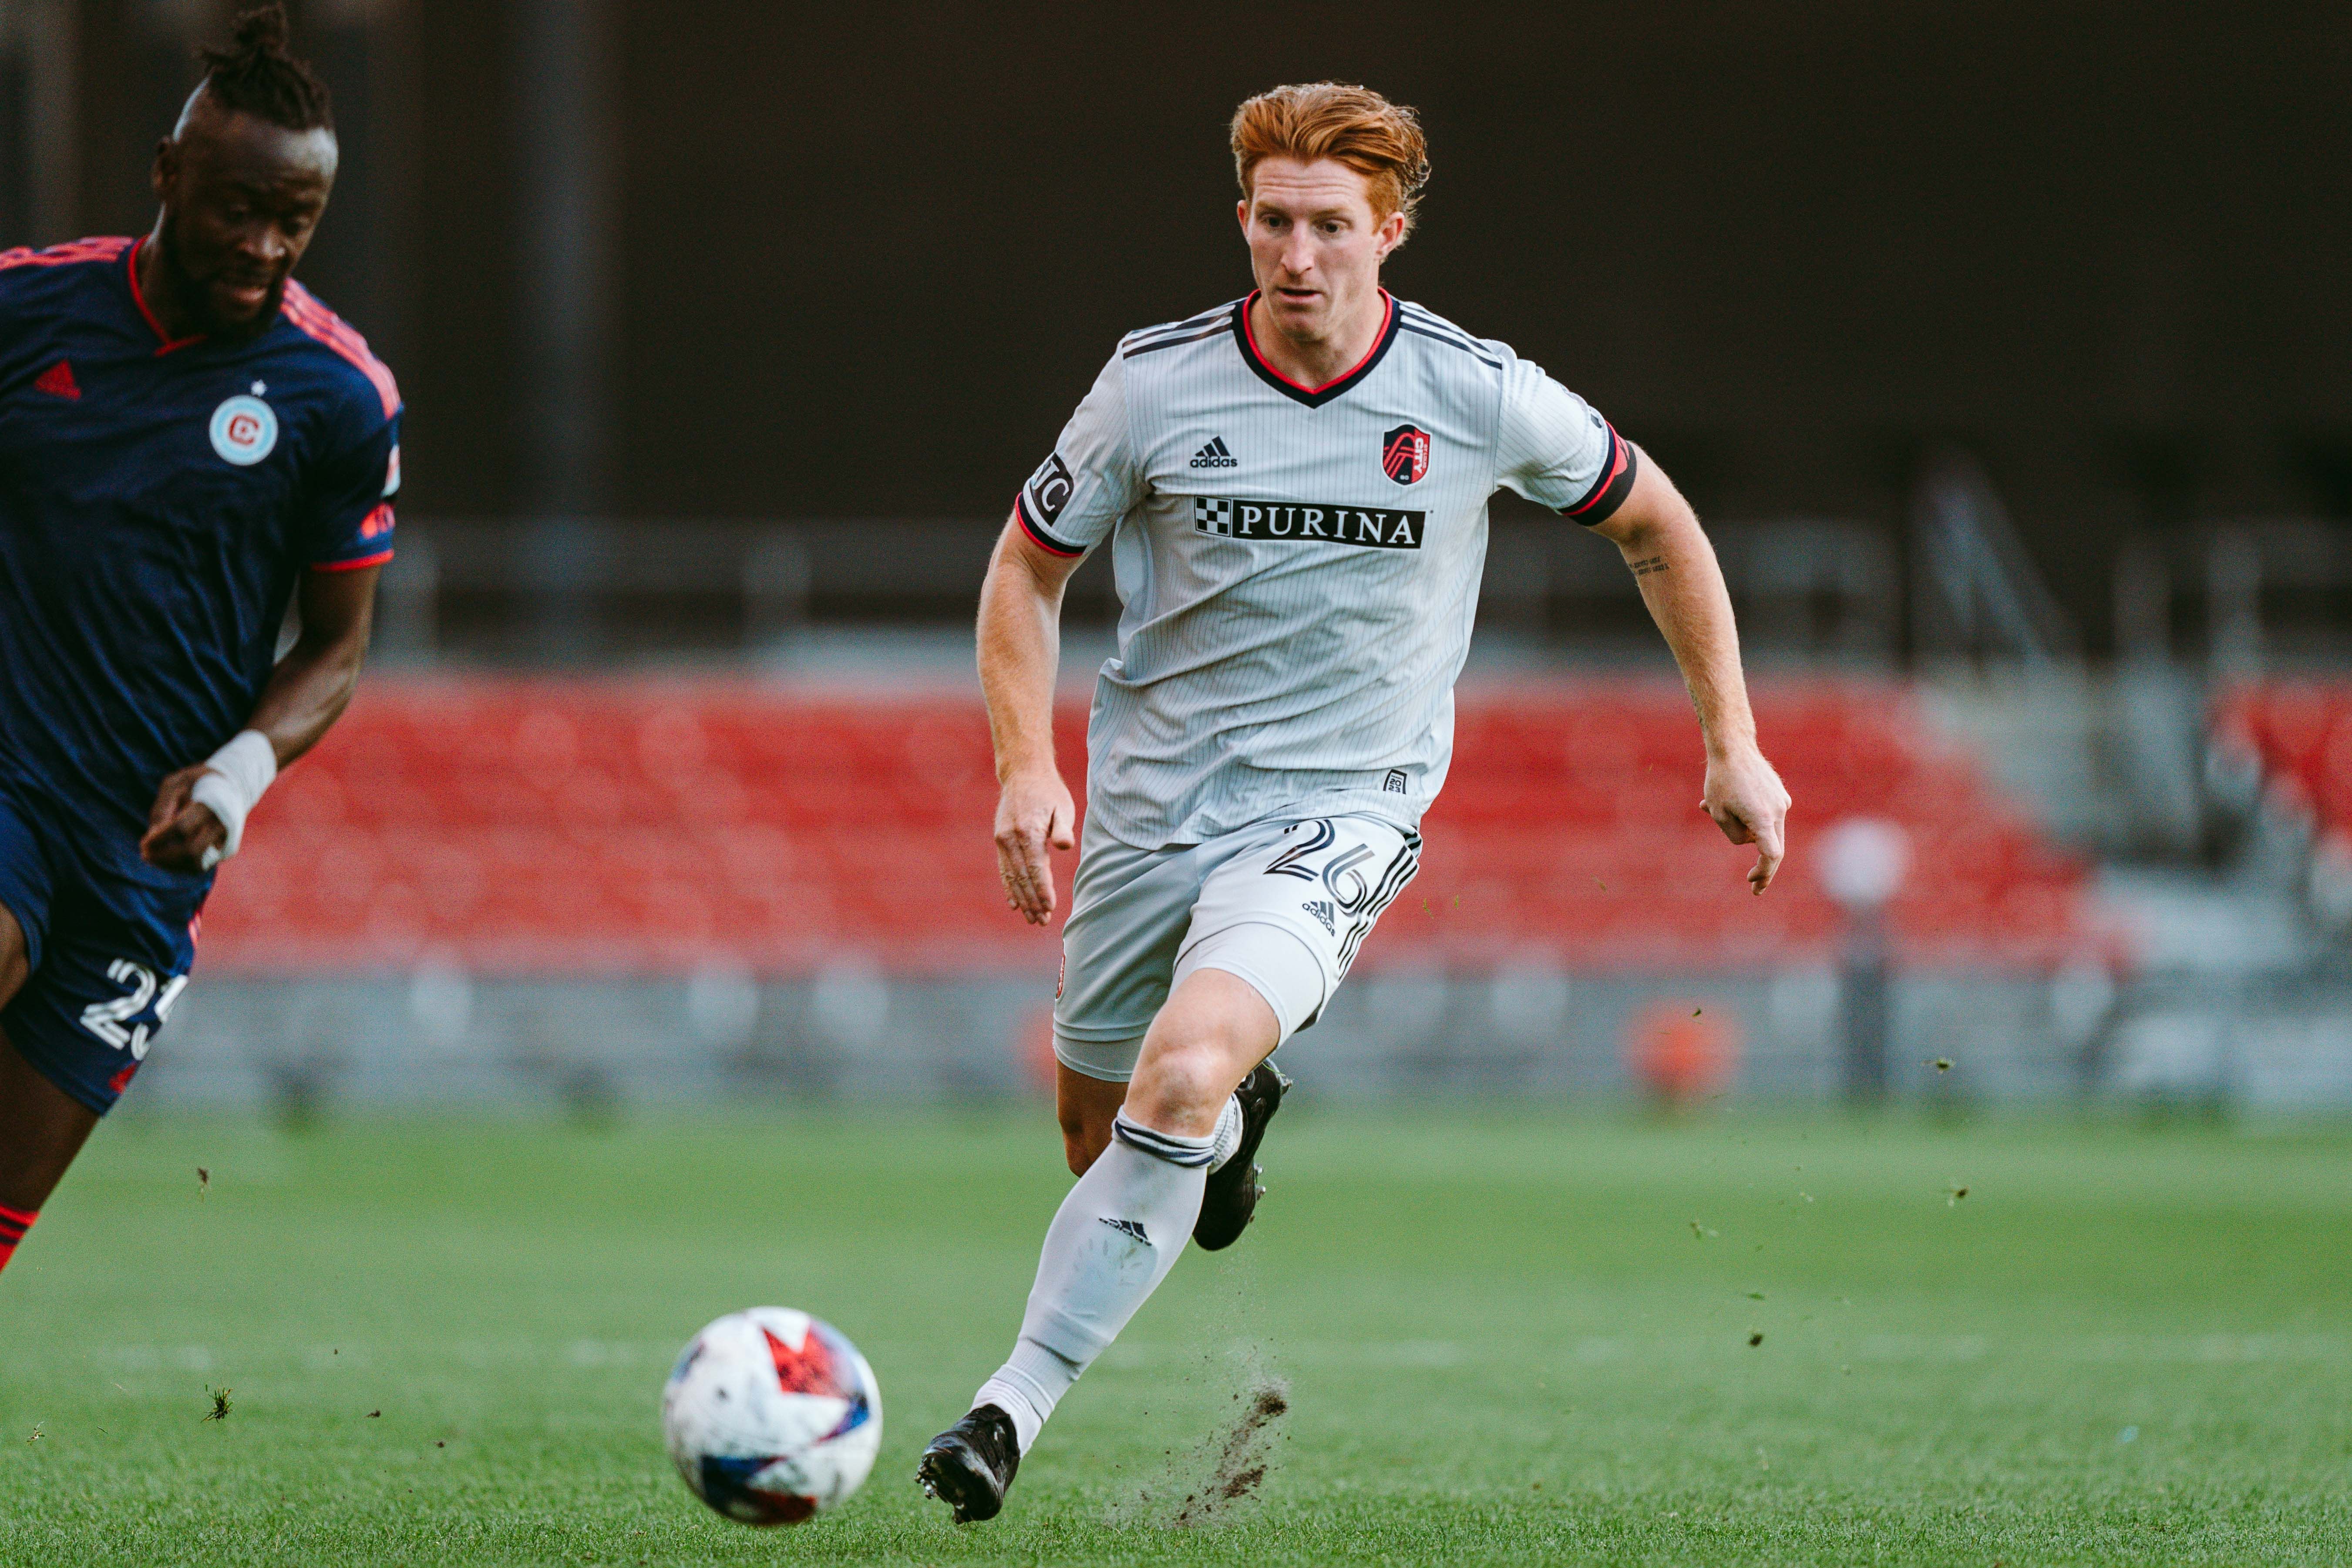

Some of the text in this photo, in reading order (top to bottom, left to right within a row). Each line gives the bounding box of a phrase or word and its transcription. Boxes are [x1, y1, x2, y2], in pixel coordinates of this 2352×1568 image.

[1190, 456, 1237, 468] adidas
[1414, 437, 1424, 474] CITY
[1240, 505, 1416, 544] PURINA
[1263, 820, 1375, 917] 26
[1302, 903, 1335, 937] adidas
